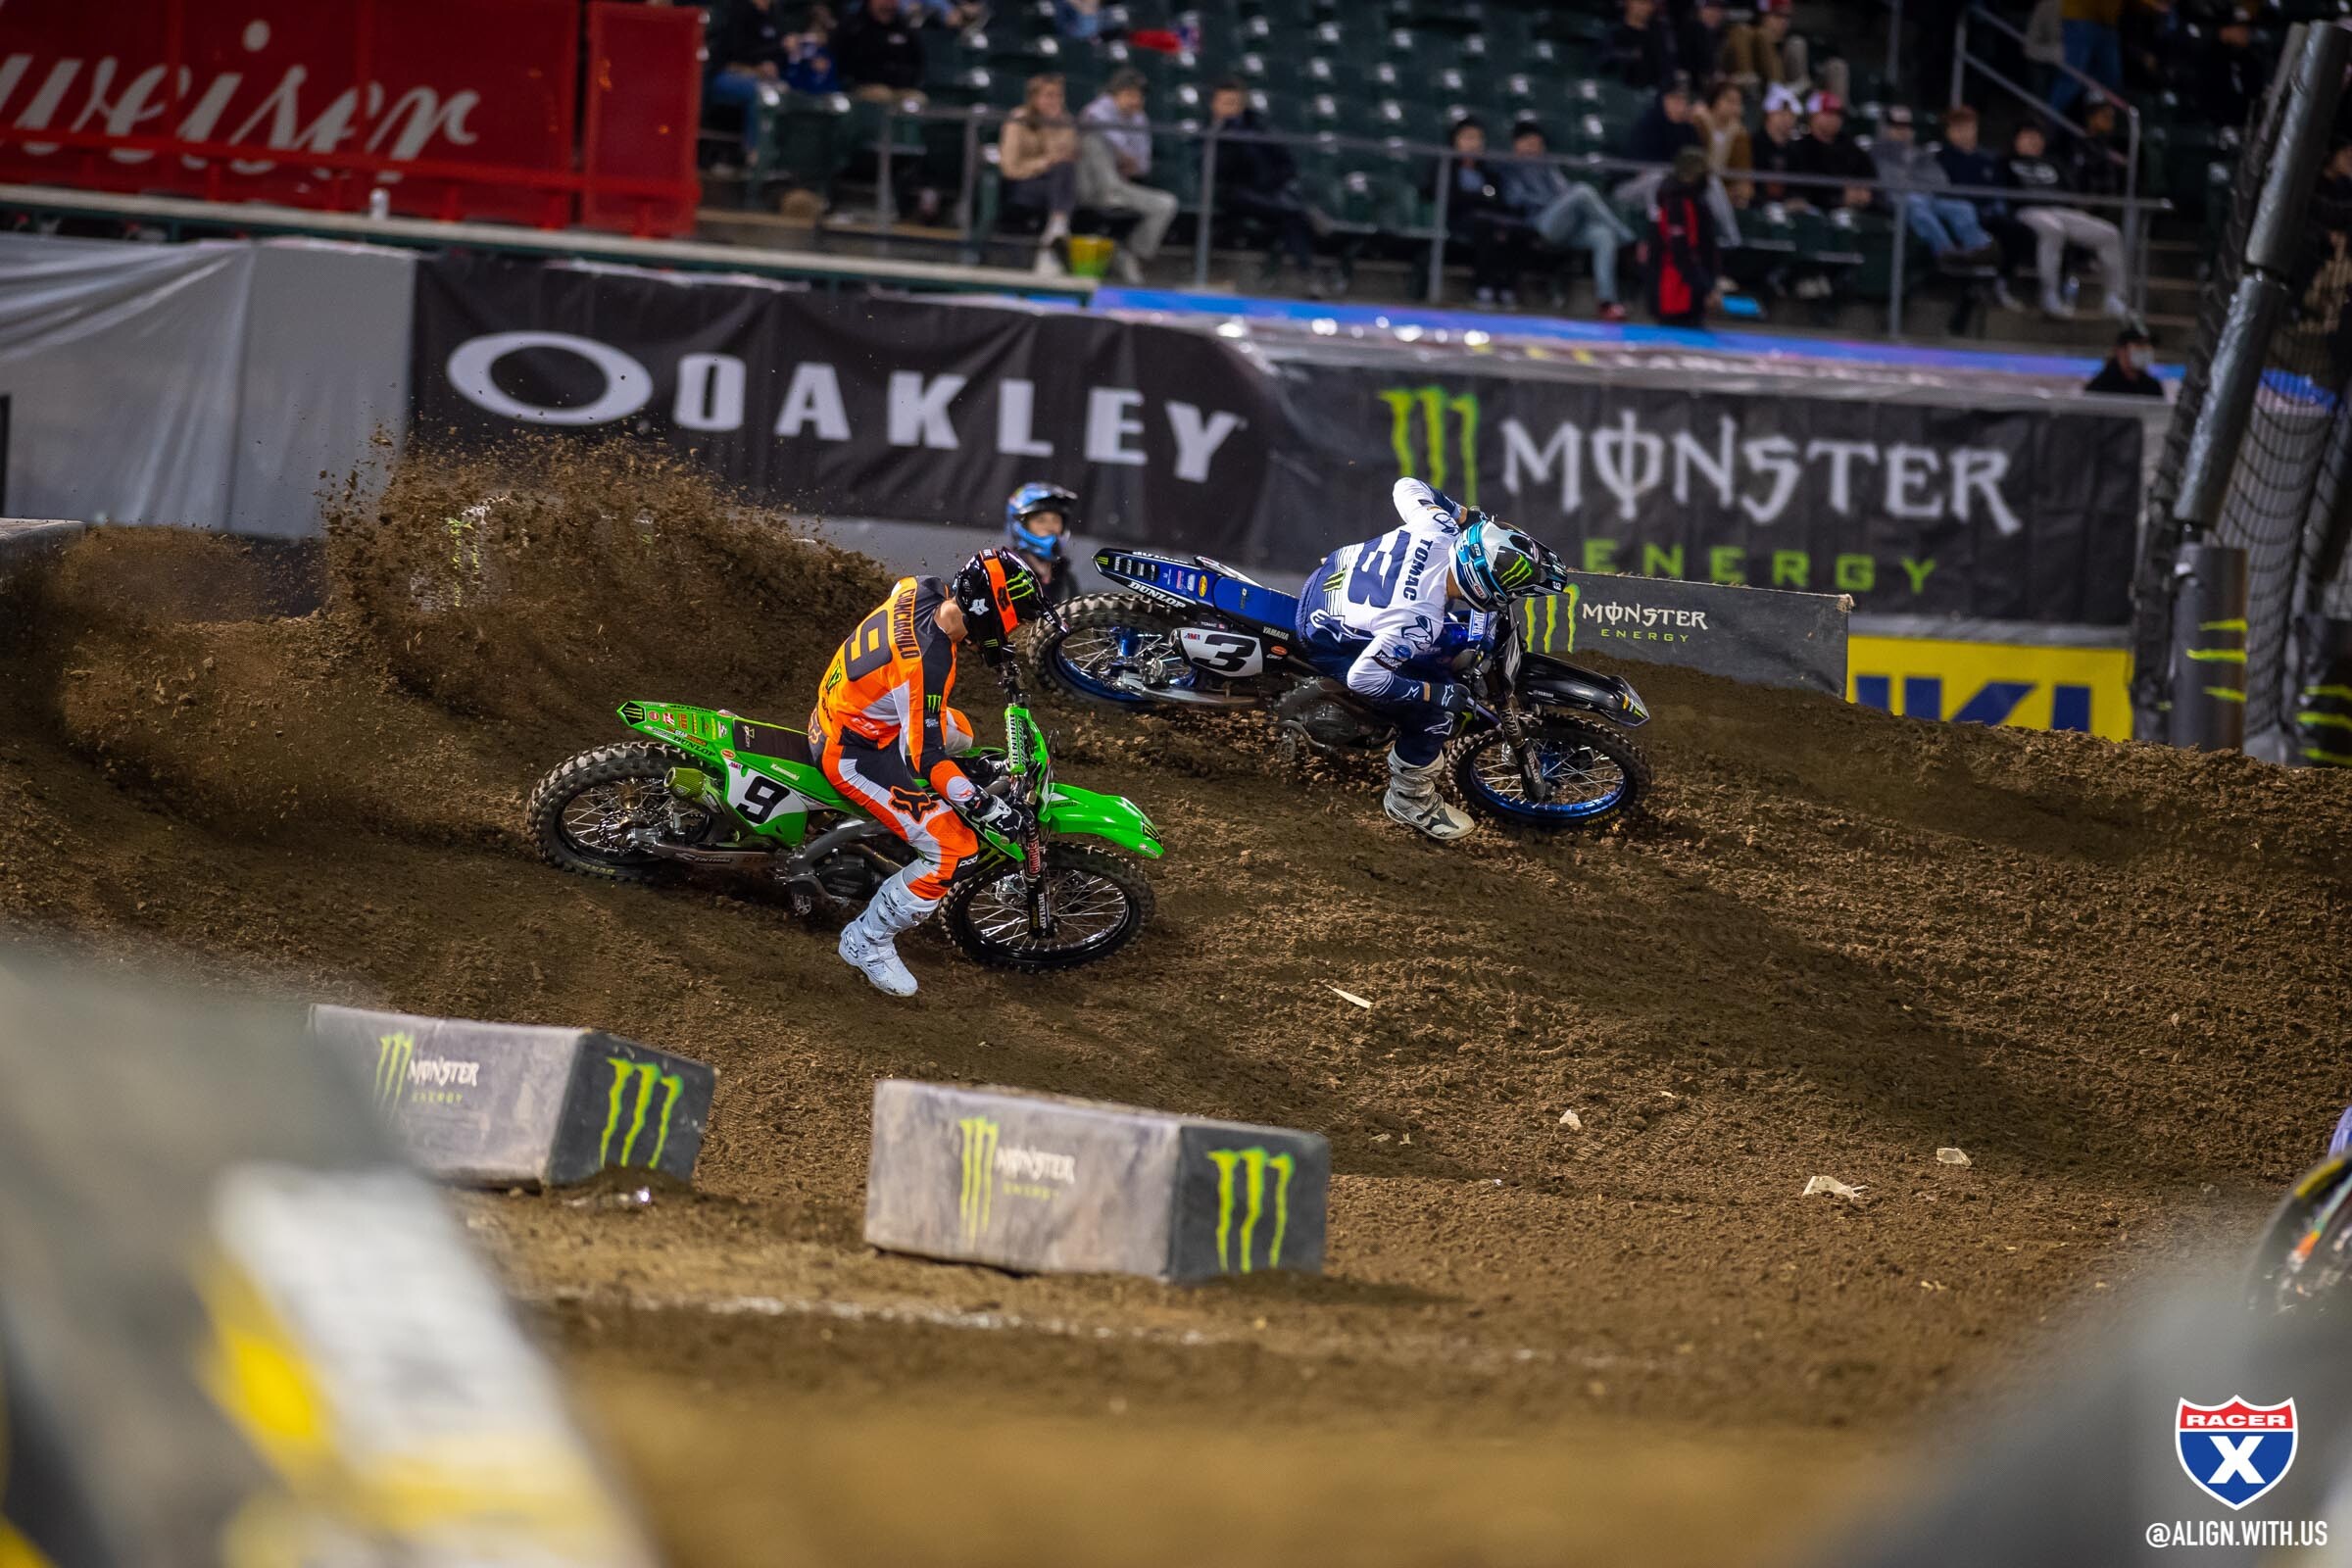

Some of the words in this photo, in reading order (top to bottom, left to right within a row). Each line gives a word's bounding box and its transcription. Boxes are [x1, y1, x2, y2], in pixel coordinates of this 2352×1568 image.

[672, 351, 1241, 483] OAKLEY
[1500, 408, 2023, 537] MONSTER
[1402, 539, 1434, 602] TOMAC
[1581, 537, 1937, 593] ENERGY
[1127, 580, 1188, 609] DUNLOP
[893, 587, 922, 661] CIANCIARULO
[1262, 625, 1291, 641] YAMAHA
[1582, 601, 1709, 630] MONSTER
[844, 609, 893, 683] 9
[1191, 633, 1258, 672] 3
[1600, 628, 1690, 643] ENERGY
[672, 736, 716, 758] DUNLOP
[735, 775, 791, 825] 9
[1028, 840, 1041, 874] SHOWA
[1038, 892, 1049, 929] DUNLOP
[407, 1055, 479, 1087] MONSTER
